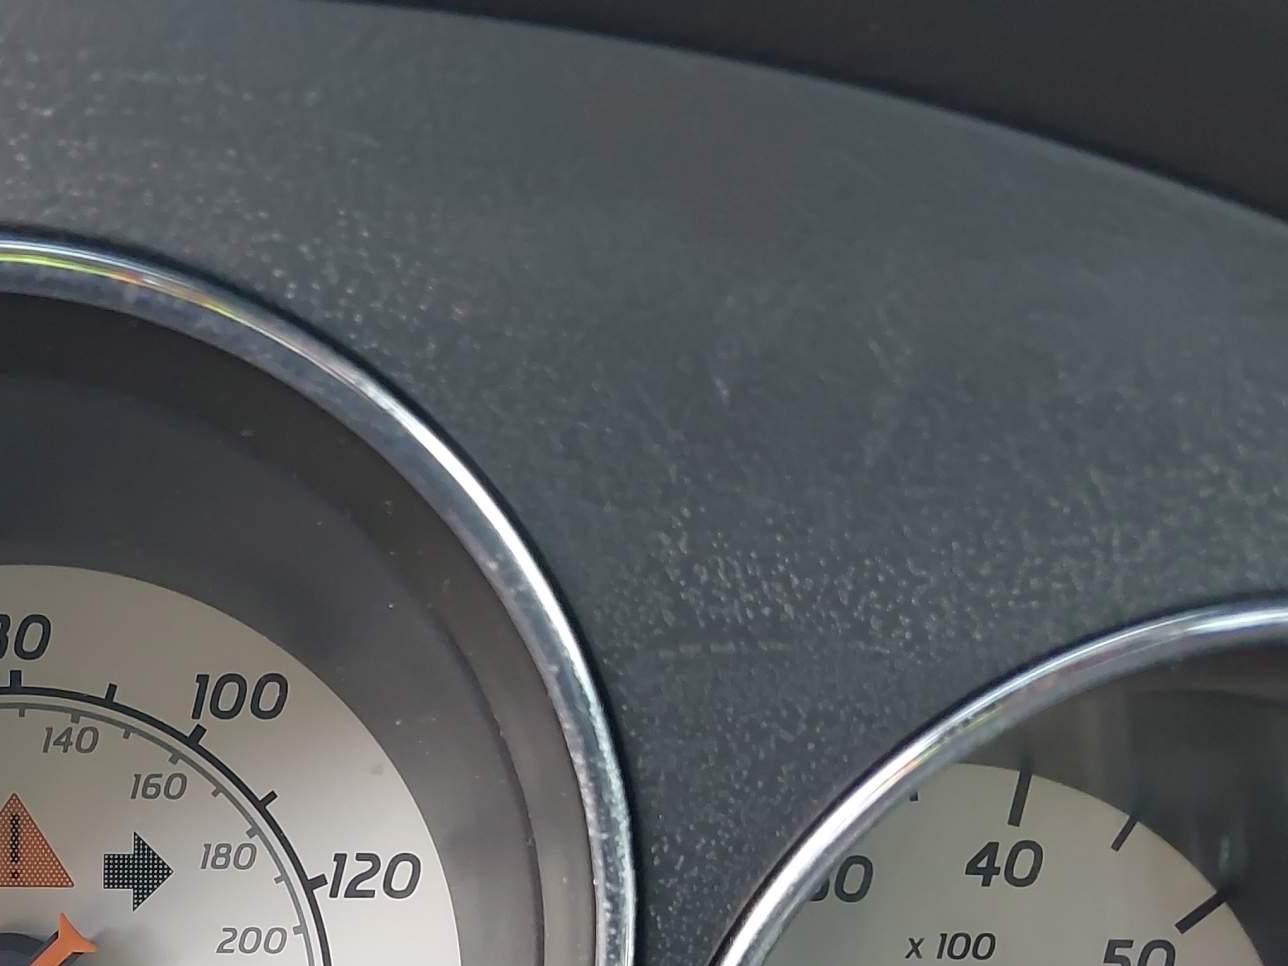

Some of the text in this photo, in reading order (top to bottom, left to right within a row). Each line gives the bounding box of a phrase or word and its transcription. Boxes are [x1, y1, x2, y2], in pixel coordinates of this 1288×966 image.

[191, 673, 290, 720] 100
[42, 726, 99, 754] 140
[130, 773, 188, 800] 160
[200, 842, 257, 870] 180
[964, 840, 1044, 888] 40
[328, 852, 422, 899] 120
[216, 927, 288, 955] 200
[905, 932, 997, 961] x 100
